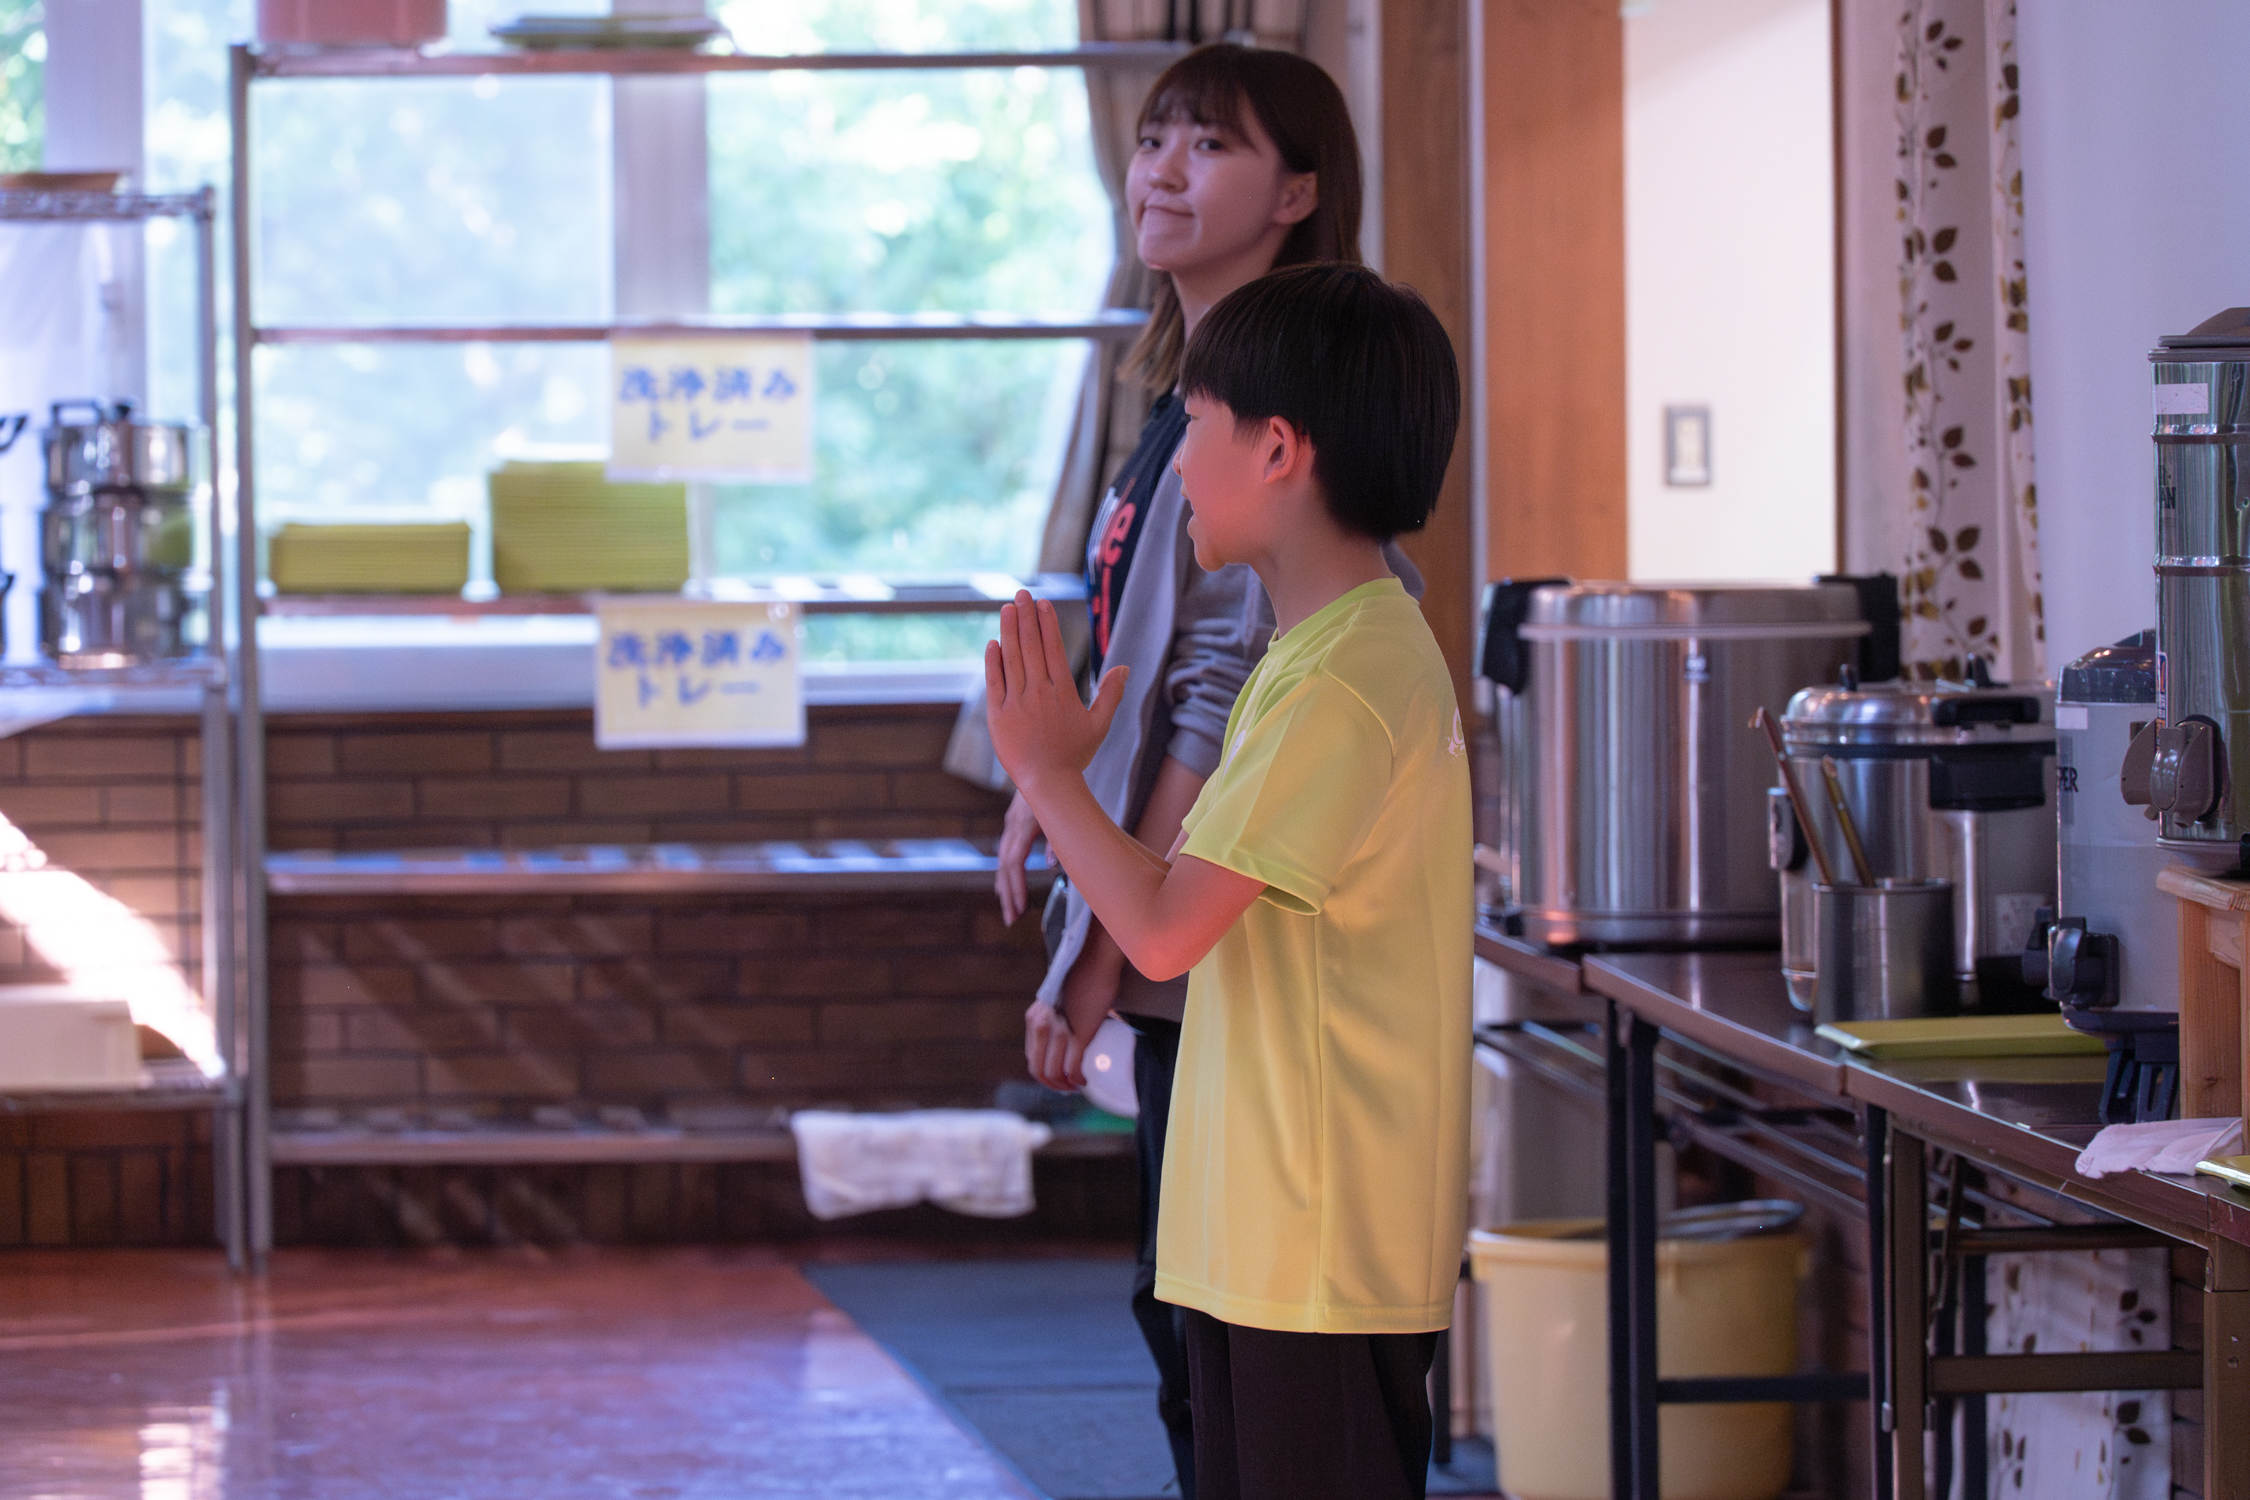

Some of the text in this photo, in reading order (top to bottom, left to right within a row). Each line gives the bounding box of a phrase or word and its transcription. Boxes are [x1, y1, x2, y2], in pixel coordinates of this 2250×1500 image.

[619, 365, 796, 404] 洗浄済み
[649, 410, 769, 442] トレー
[608, 628, 785, 669] 洗浄済み
[638, 675, 760, 709] トレー
